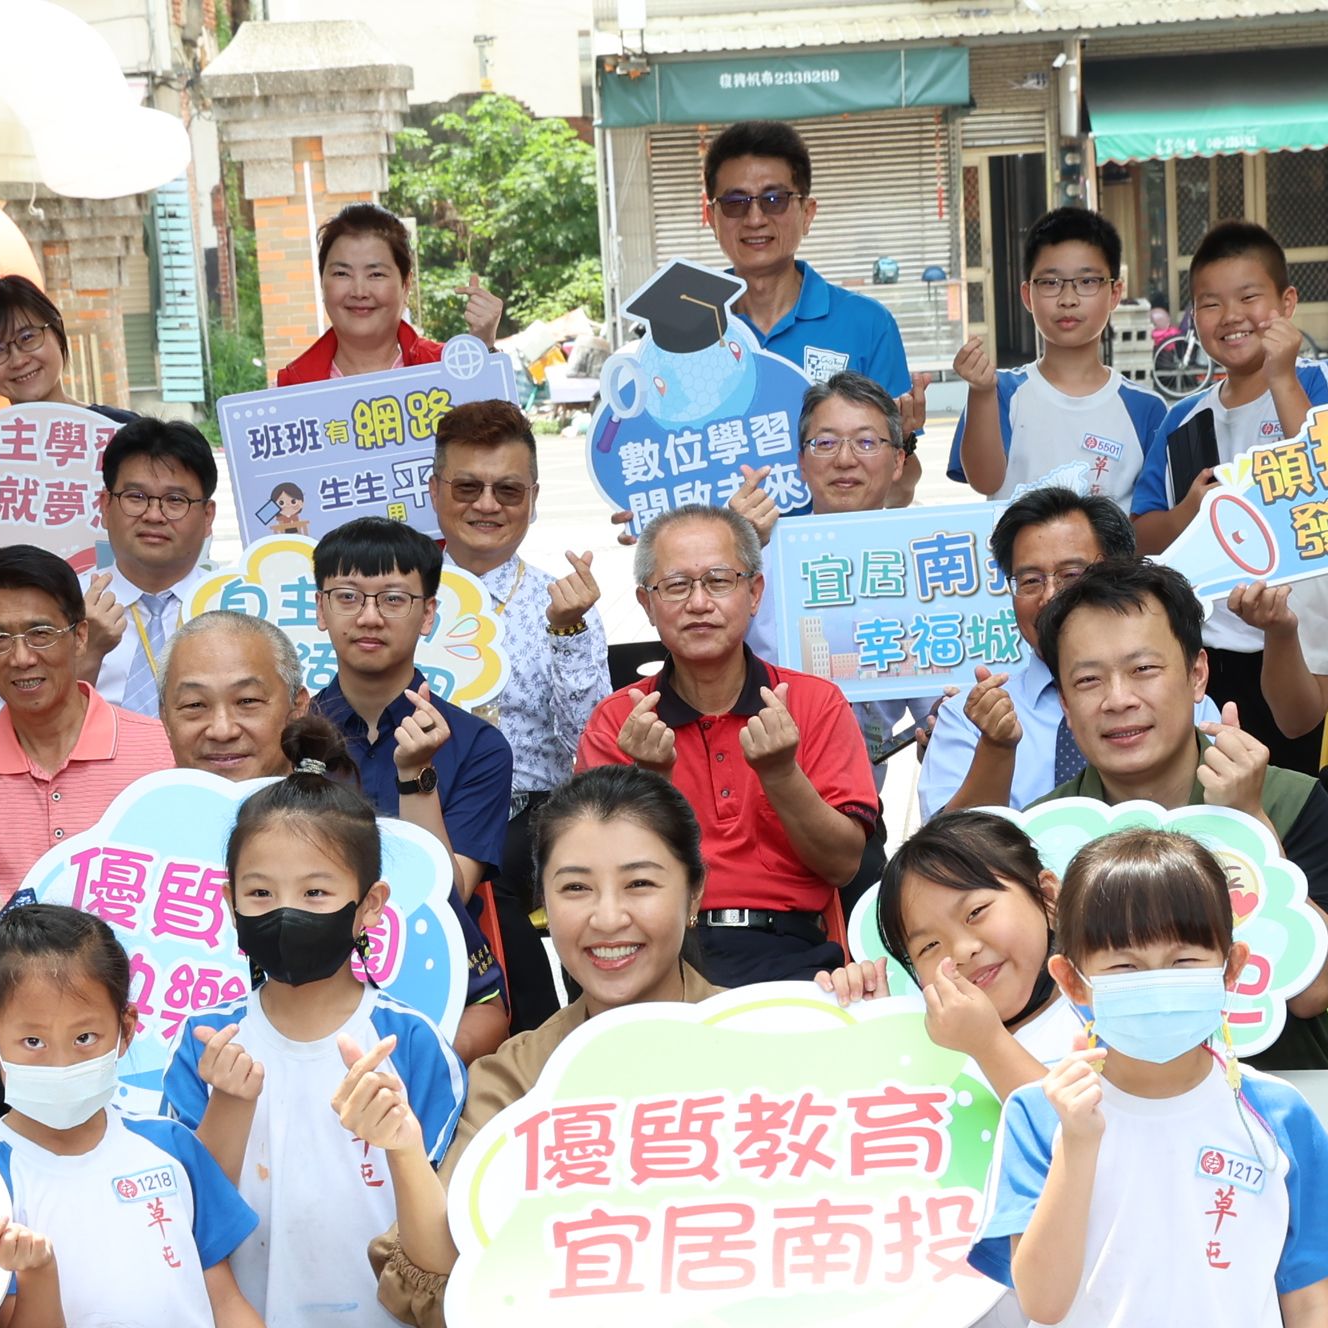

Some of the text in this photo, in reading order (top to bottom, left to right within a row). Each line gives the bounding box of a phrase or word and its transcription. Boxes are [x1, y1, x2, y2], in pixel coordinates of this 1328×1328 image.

[247, 387, 454, 461] 班班有網路
[618, 411, 792, 486] 數位學習
[1097, 440, 1120, 456] 5501
[855, 608, 1021, 671] 幸福城
[513, 1086, 954, 1192] 優質教育
[1226, 1159, 1264, 1187] 1217
[137, 1171, 172, 1192] 1218
[146, 1198, 183, 1269] 草屯
[548, 1195, 983, 1300] 宜居南投
[1205, 1187, 1238, 1270] 草屯
